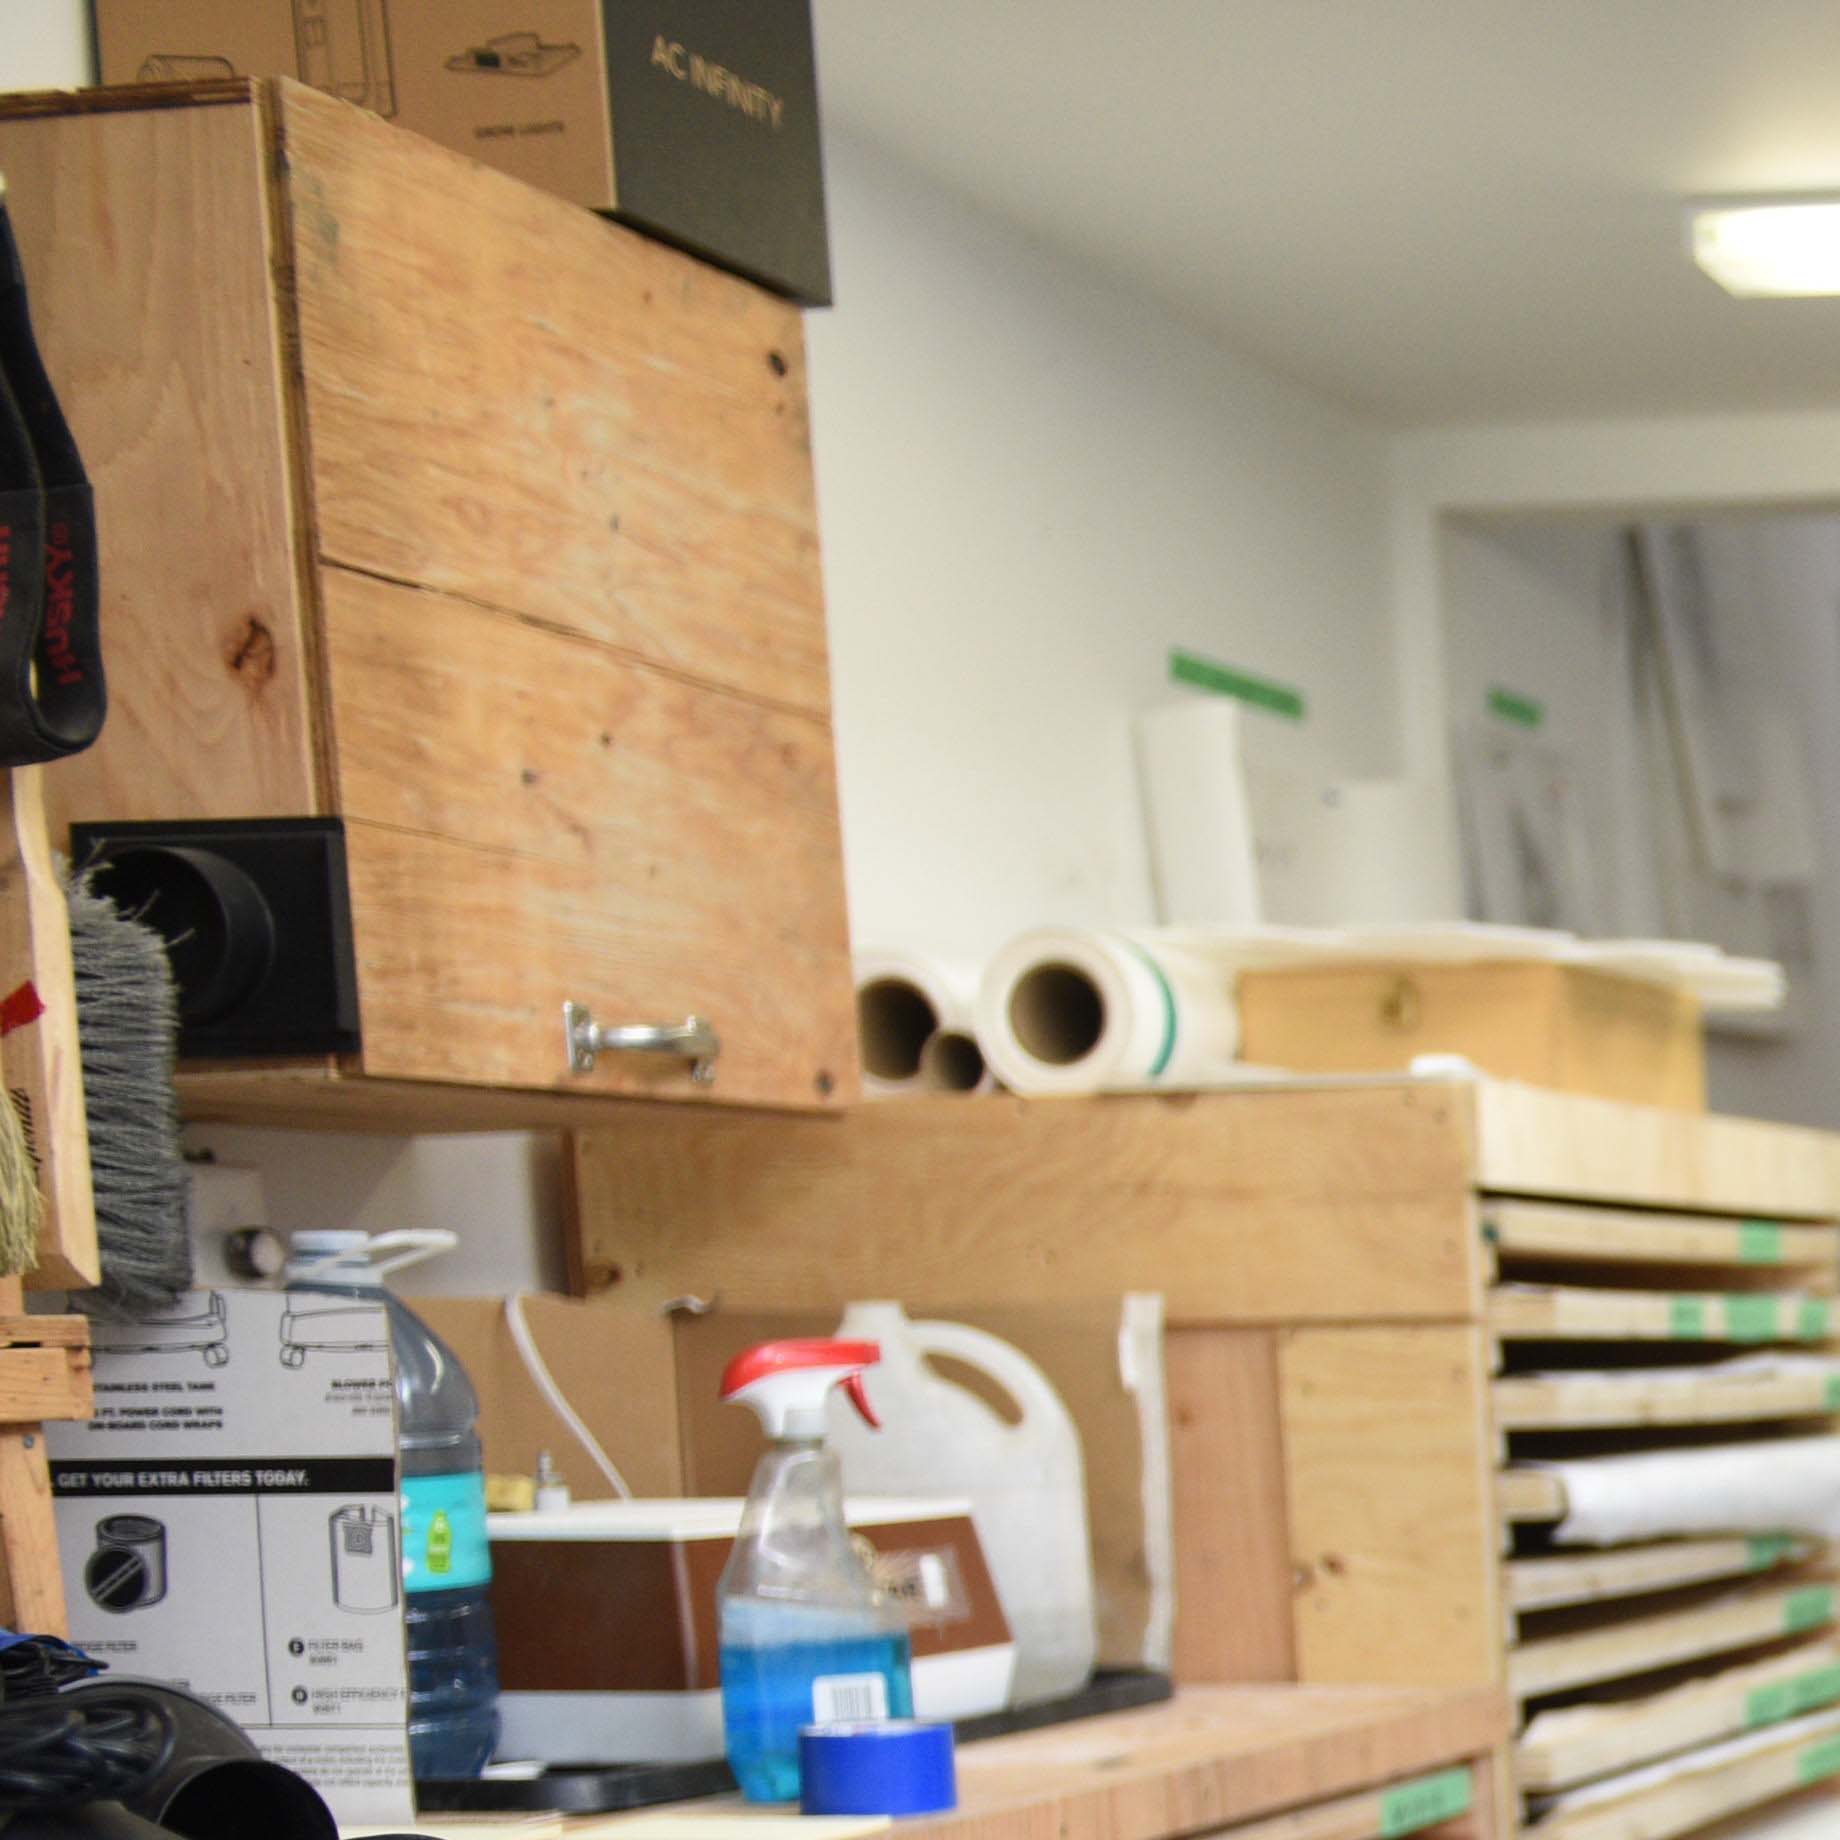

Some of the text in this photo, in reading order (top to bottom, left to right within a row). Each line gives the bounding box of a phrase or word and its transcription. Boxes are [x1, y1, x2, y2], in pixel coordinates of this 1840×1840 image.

[651, 34, 784, 129] AC INFINITY
[93, 1381, 148, 1393] TAINLESS
[57, 1472, 89, 1488] GET
[91, 1472, 135, 1488] YOUR
[137, 1471, 189, 1488] EXTRA
[193, 1470, 251, 1487] FILTERS
